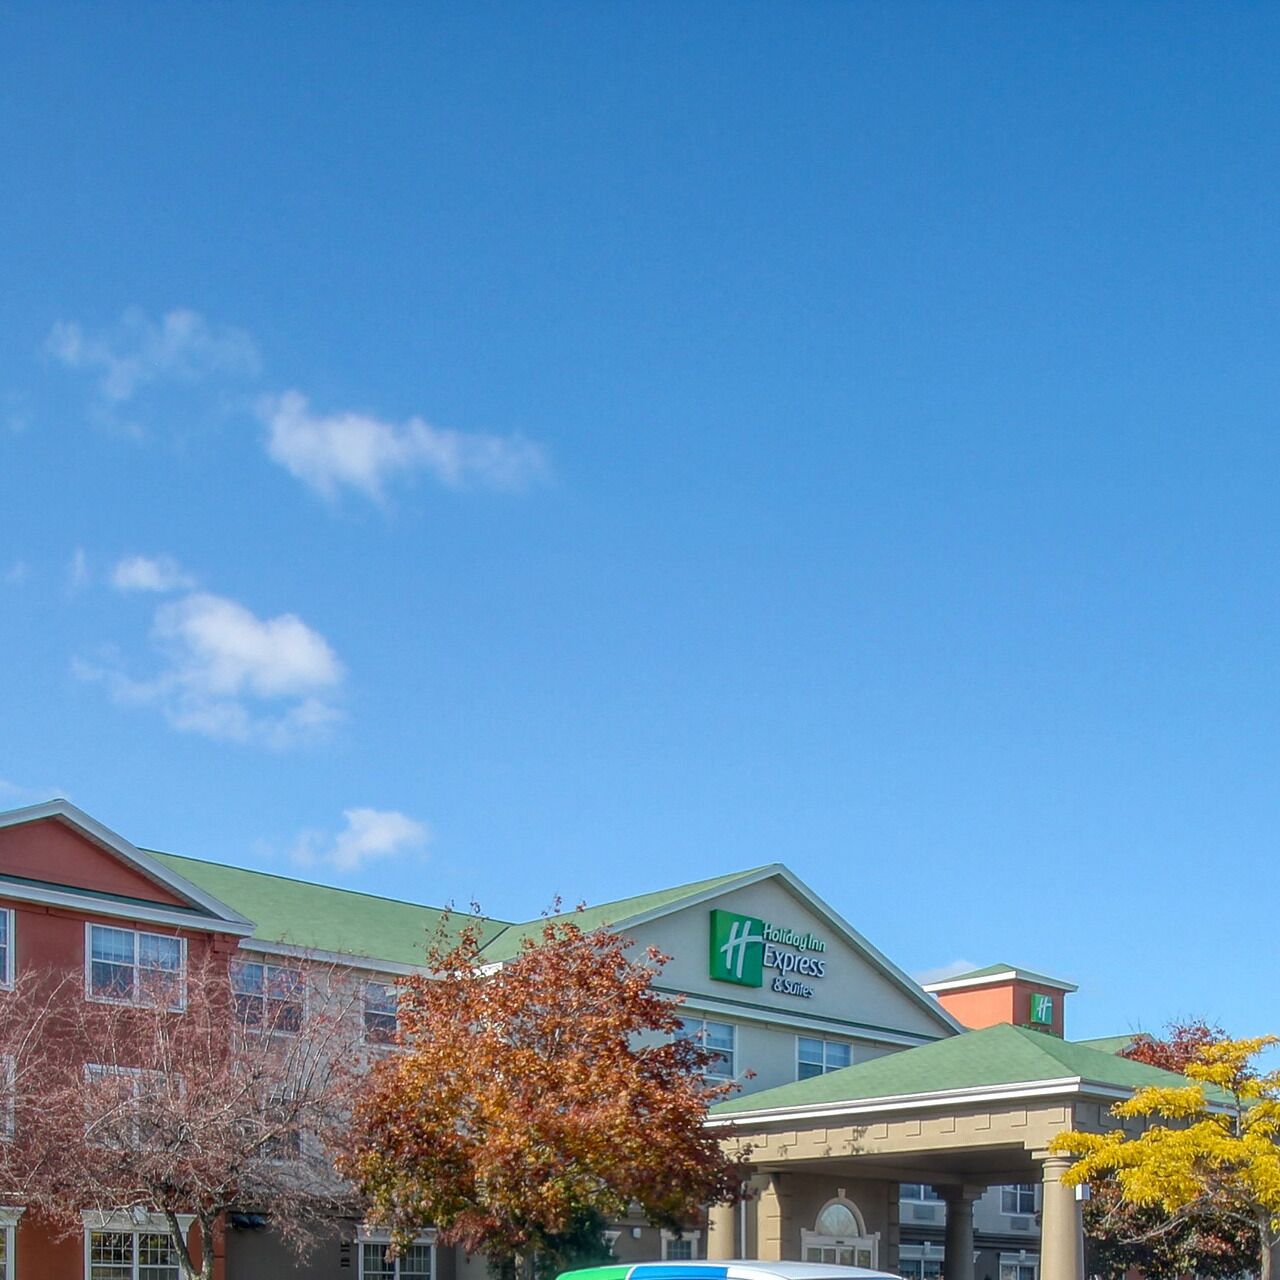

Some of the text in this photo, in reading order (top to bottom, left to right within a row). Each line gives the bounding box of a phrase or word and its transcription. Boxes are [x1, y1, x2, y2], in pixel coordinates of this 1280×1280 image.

[763, 923, 826, 952] Holiday Inn
[763, 943, 826, 978] Express
[774, 977, 814, 998] & Suites
